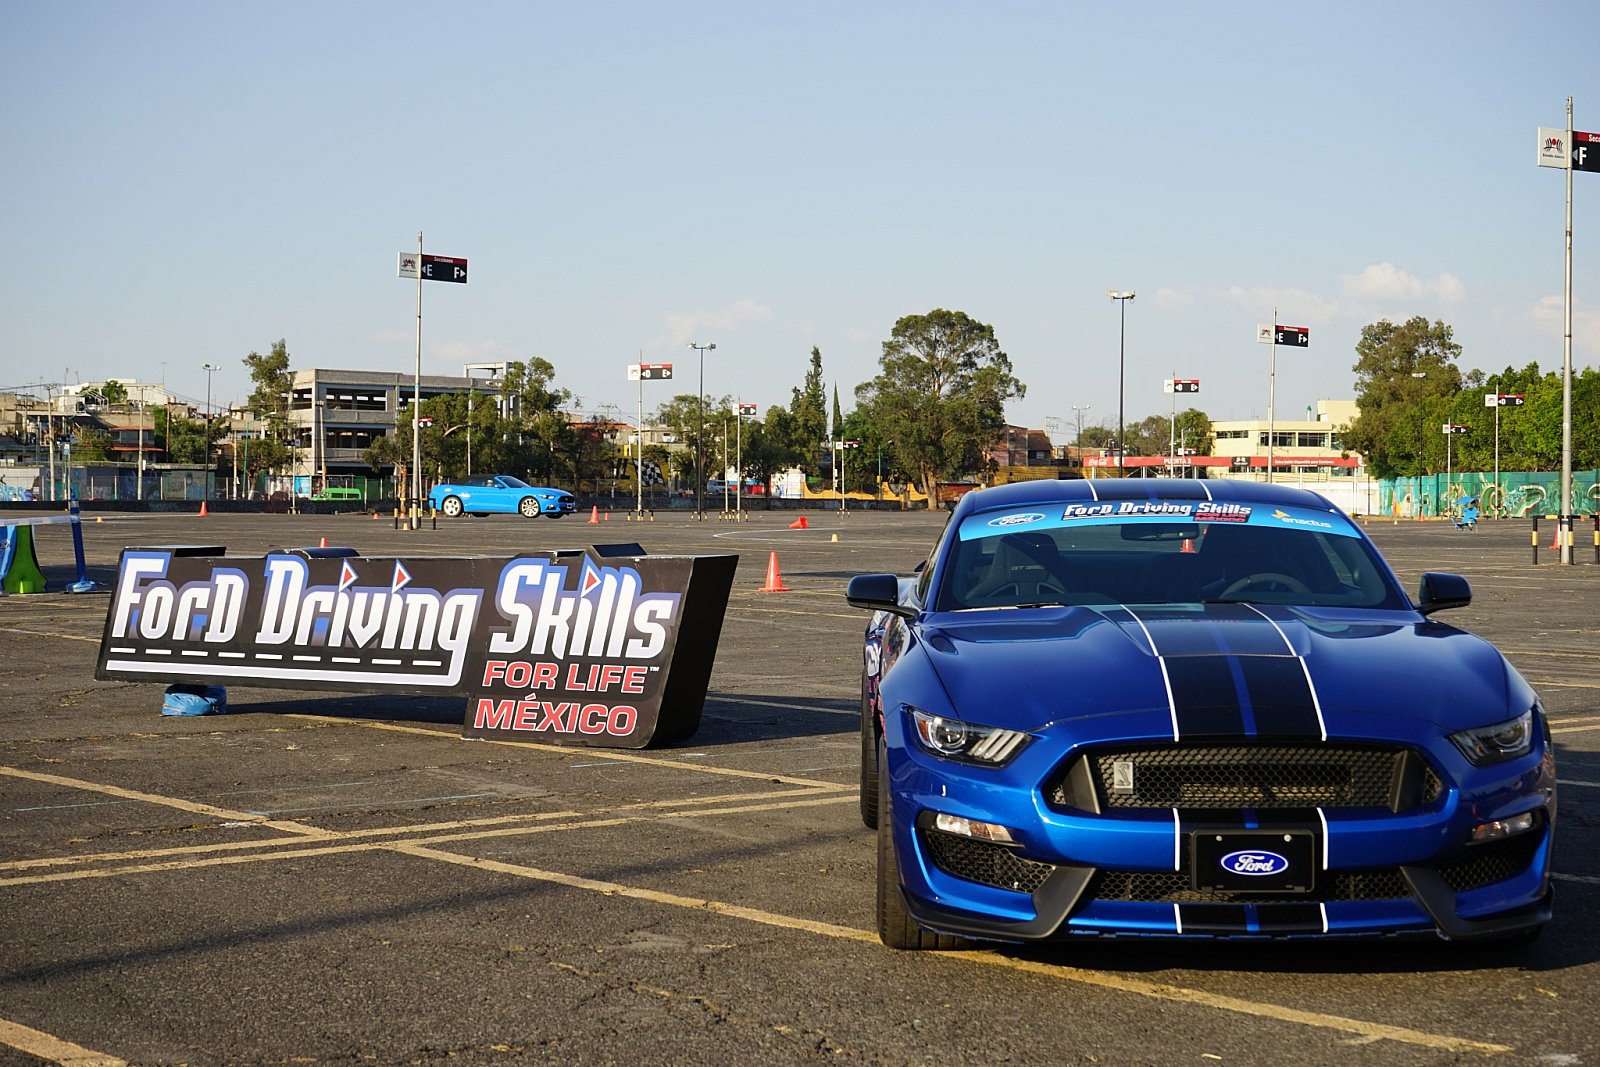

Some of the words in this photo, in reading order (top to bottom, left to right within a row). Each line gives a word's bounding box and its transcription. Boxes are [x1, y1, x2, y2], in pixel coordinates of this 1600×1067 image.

[1579, 146, 1588, 165] F
[427, 264, 433, 277] E
[453, 267, 460, 279] F
[1279, 333, 1284, 343] E
[1298, 334, 1304, 343] F
[1118, 501, 1192, 516] Driving
[1197, 502, 1251, 515] Skills
[1281, 517, 1333, 529] enactus
[255, 558, 481, 686] Driving
[489, 562, 674, 660] Skills
[482, 661, 559, 691] FOR
[474, 693, 638, 737] MÉXICO
[1234, 854, 1275, 872] Ford
